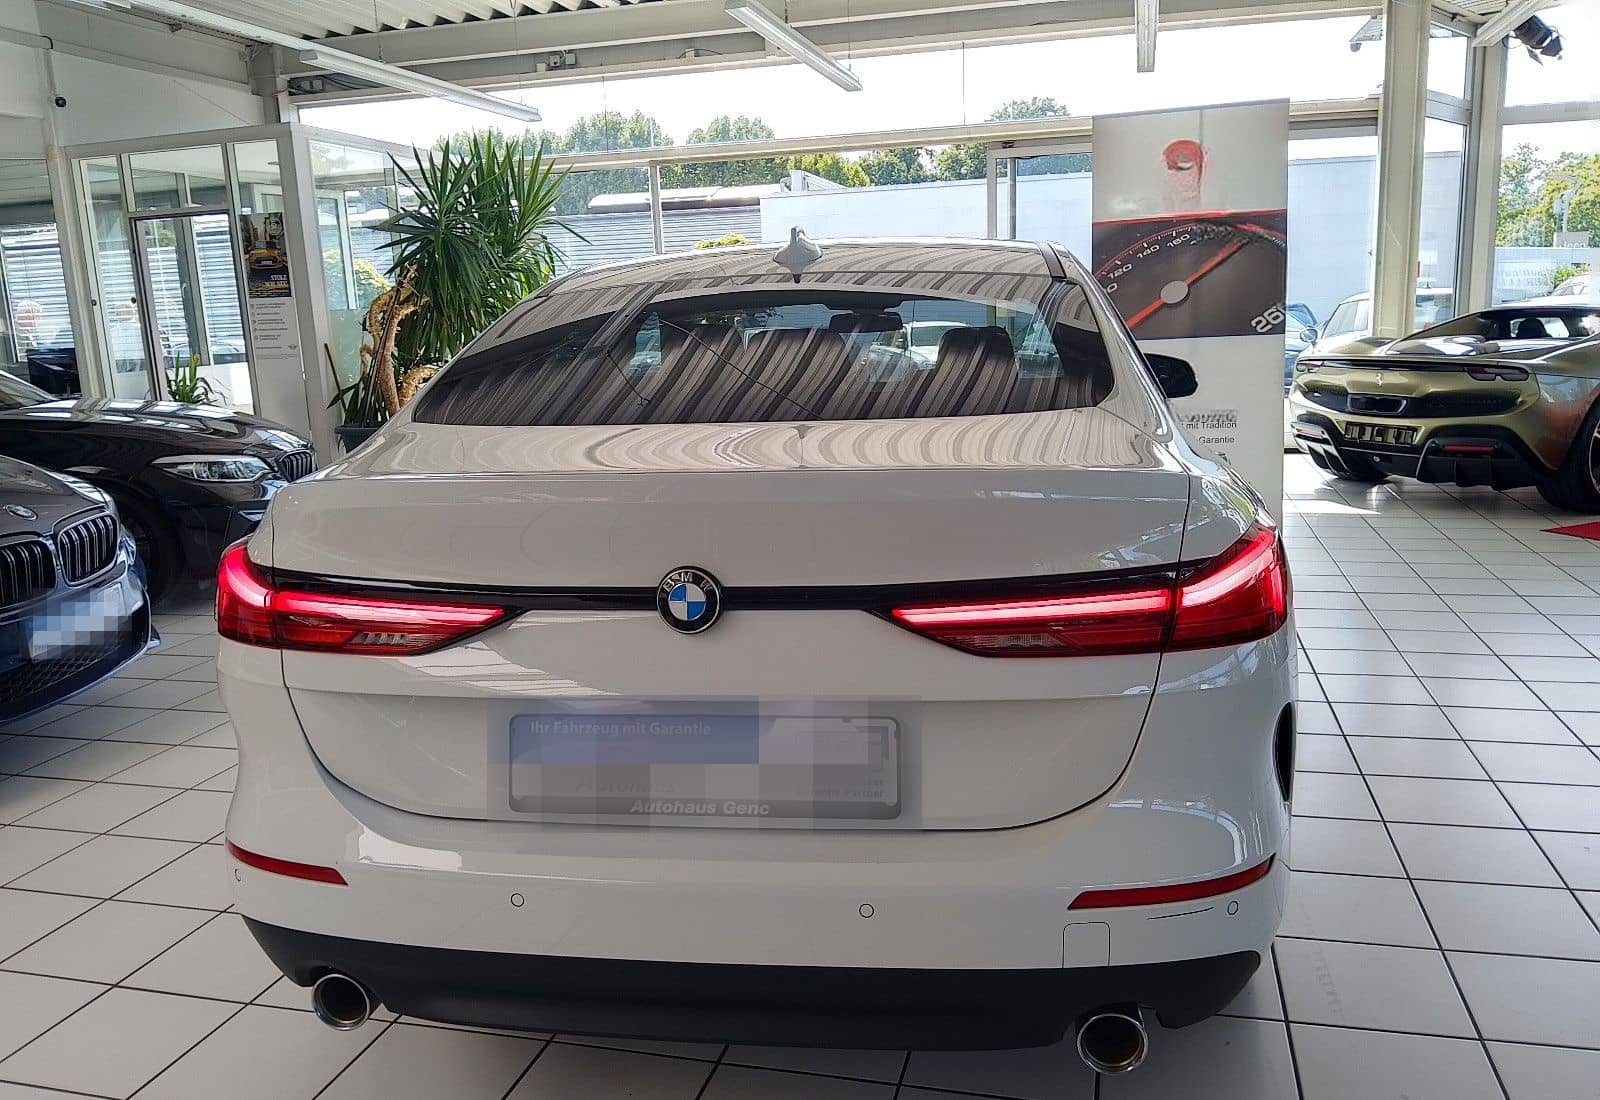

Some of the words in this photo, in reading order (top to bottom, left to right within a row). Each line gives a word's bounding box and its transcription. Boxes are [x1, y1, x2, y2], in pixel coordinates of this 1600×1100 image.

[1136, 244, 1160, 259] 140
[1107, 263, 1133, 279] 120
[1186, 422, 1199, 430] mit
[1201, 421, 1237, 429] Tradition
[1198, 436, 1235, 444] Garantie
[662, 571, 713, 593] BMW
[530, 720, 551, 736] Ihr
[553, 721, 620, 738] Fahrzeug
[622, 721, 647, 736] mit
[650, 721, 712, 736] Garantie
[630, 799, 716, 815] Autohaus
[723, 800, 770, 816] Genc
